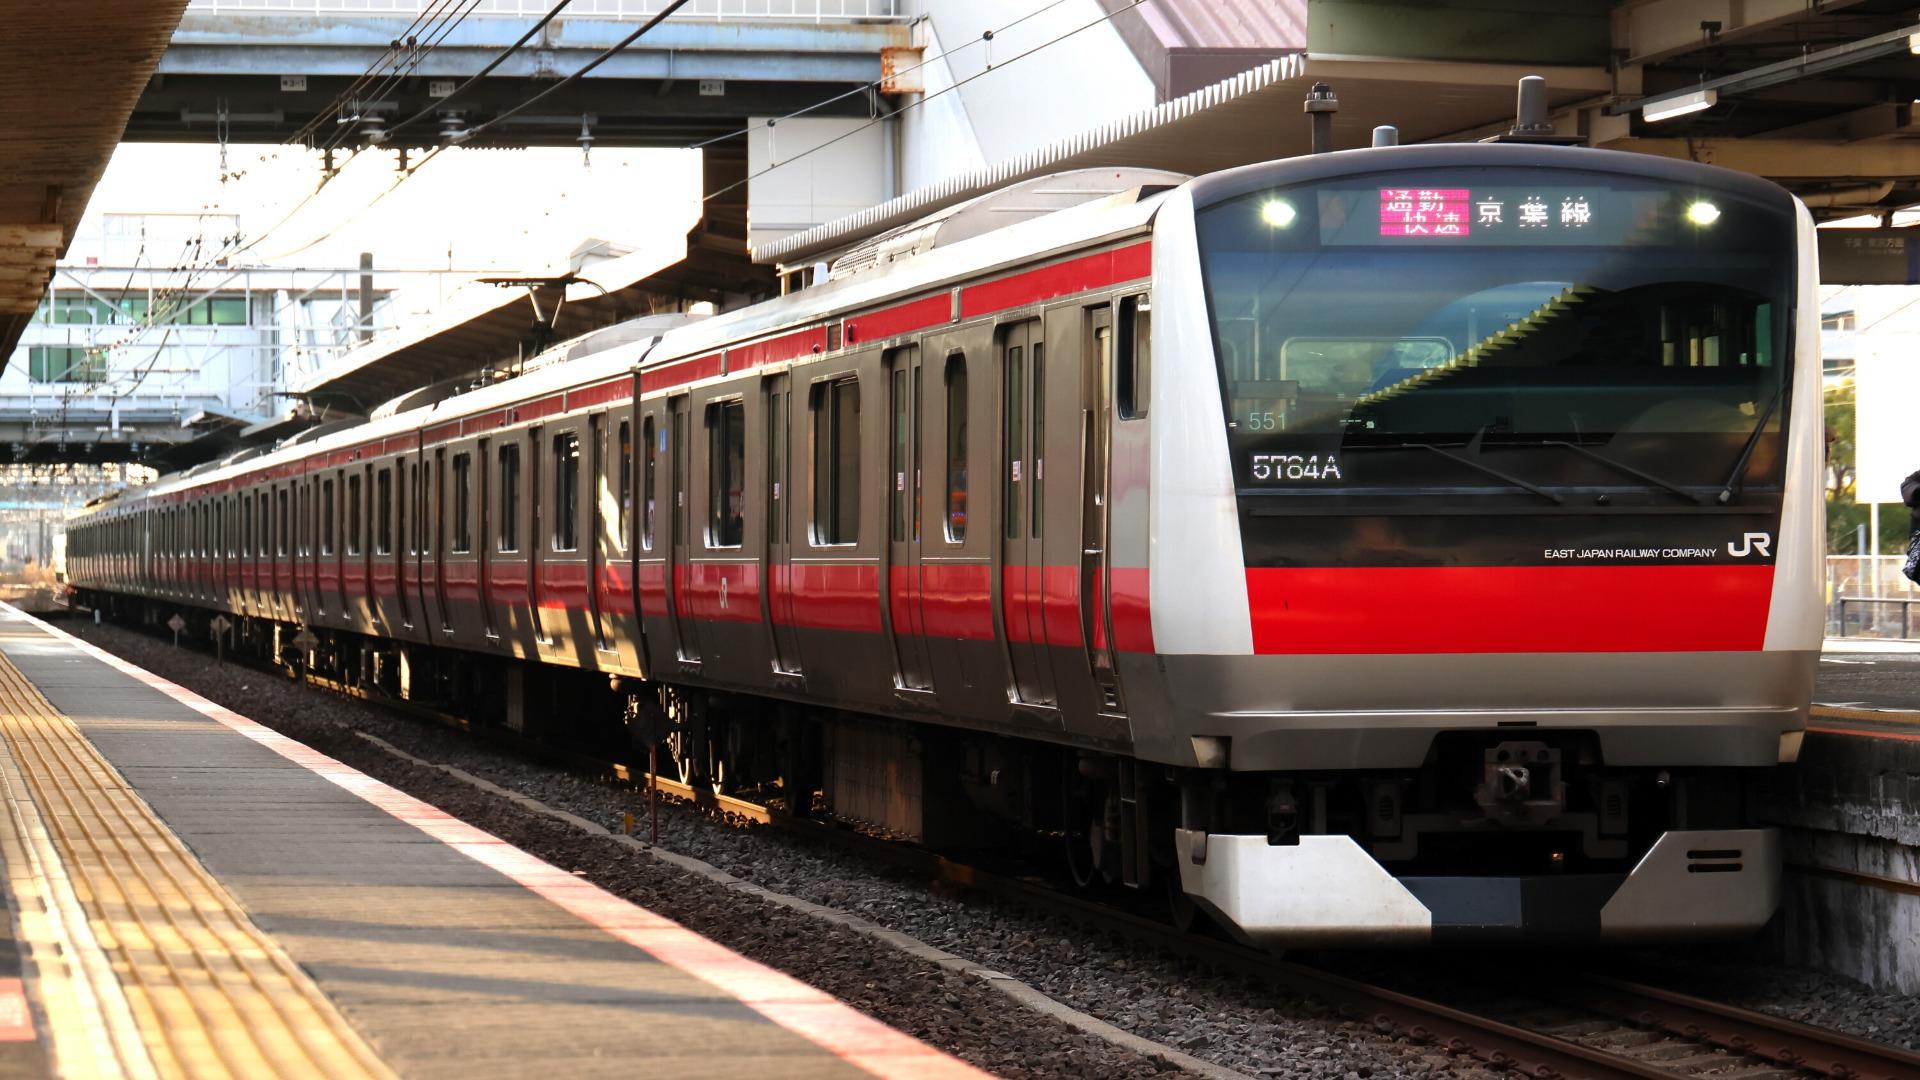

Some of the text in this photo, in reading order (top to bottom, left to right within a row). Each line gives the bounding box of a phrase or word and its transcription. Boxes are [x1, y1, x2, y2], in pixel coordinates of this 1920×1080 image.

[1386, 190, 1444, 212] 通勤
[1475, 196, 1592, 228] 京葉線
[1403, 212, 1461, 234] 快速
[1249, 412, 1287, 430] 551
[1544, 548, 1717, 559] EAST JAPAN RAILWAY COMPANY
[1727, 532, 1771, 557] JR
